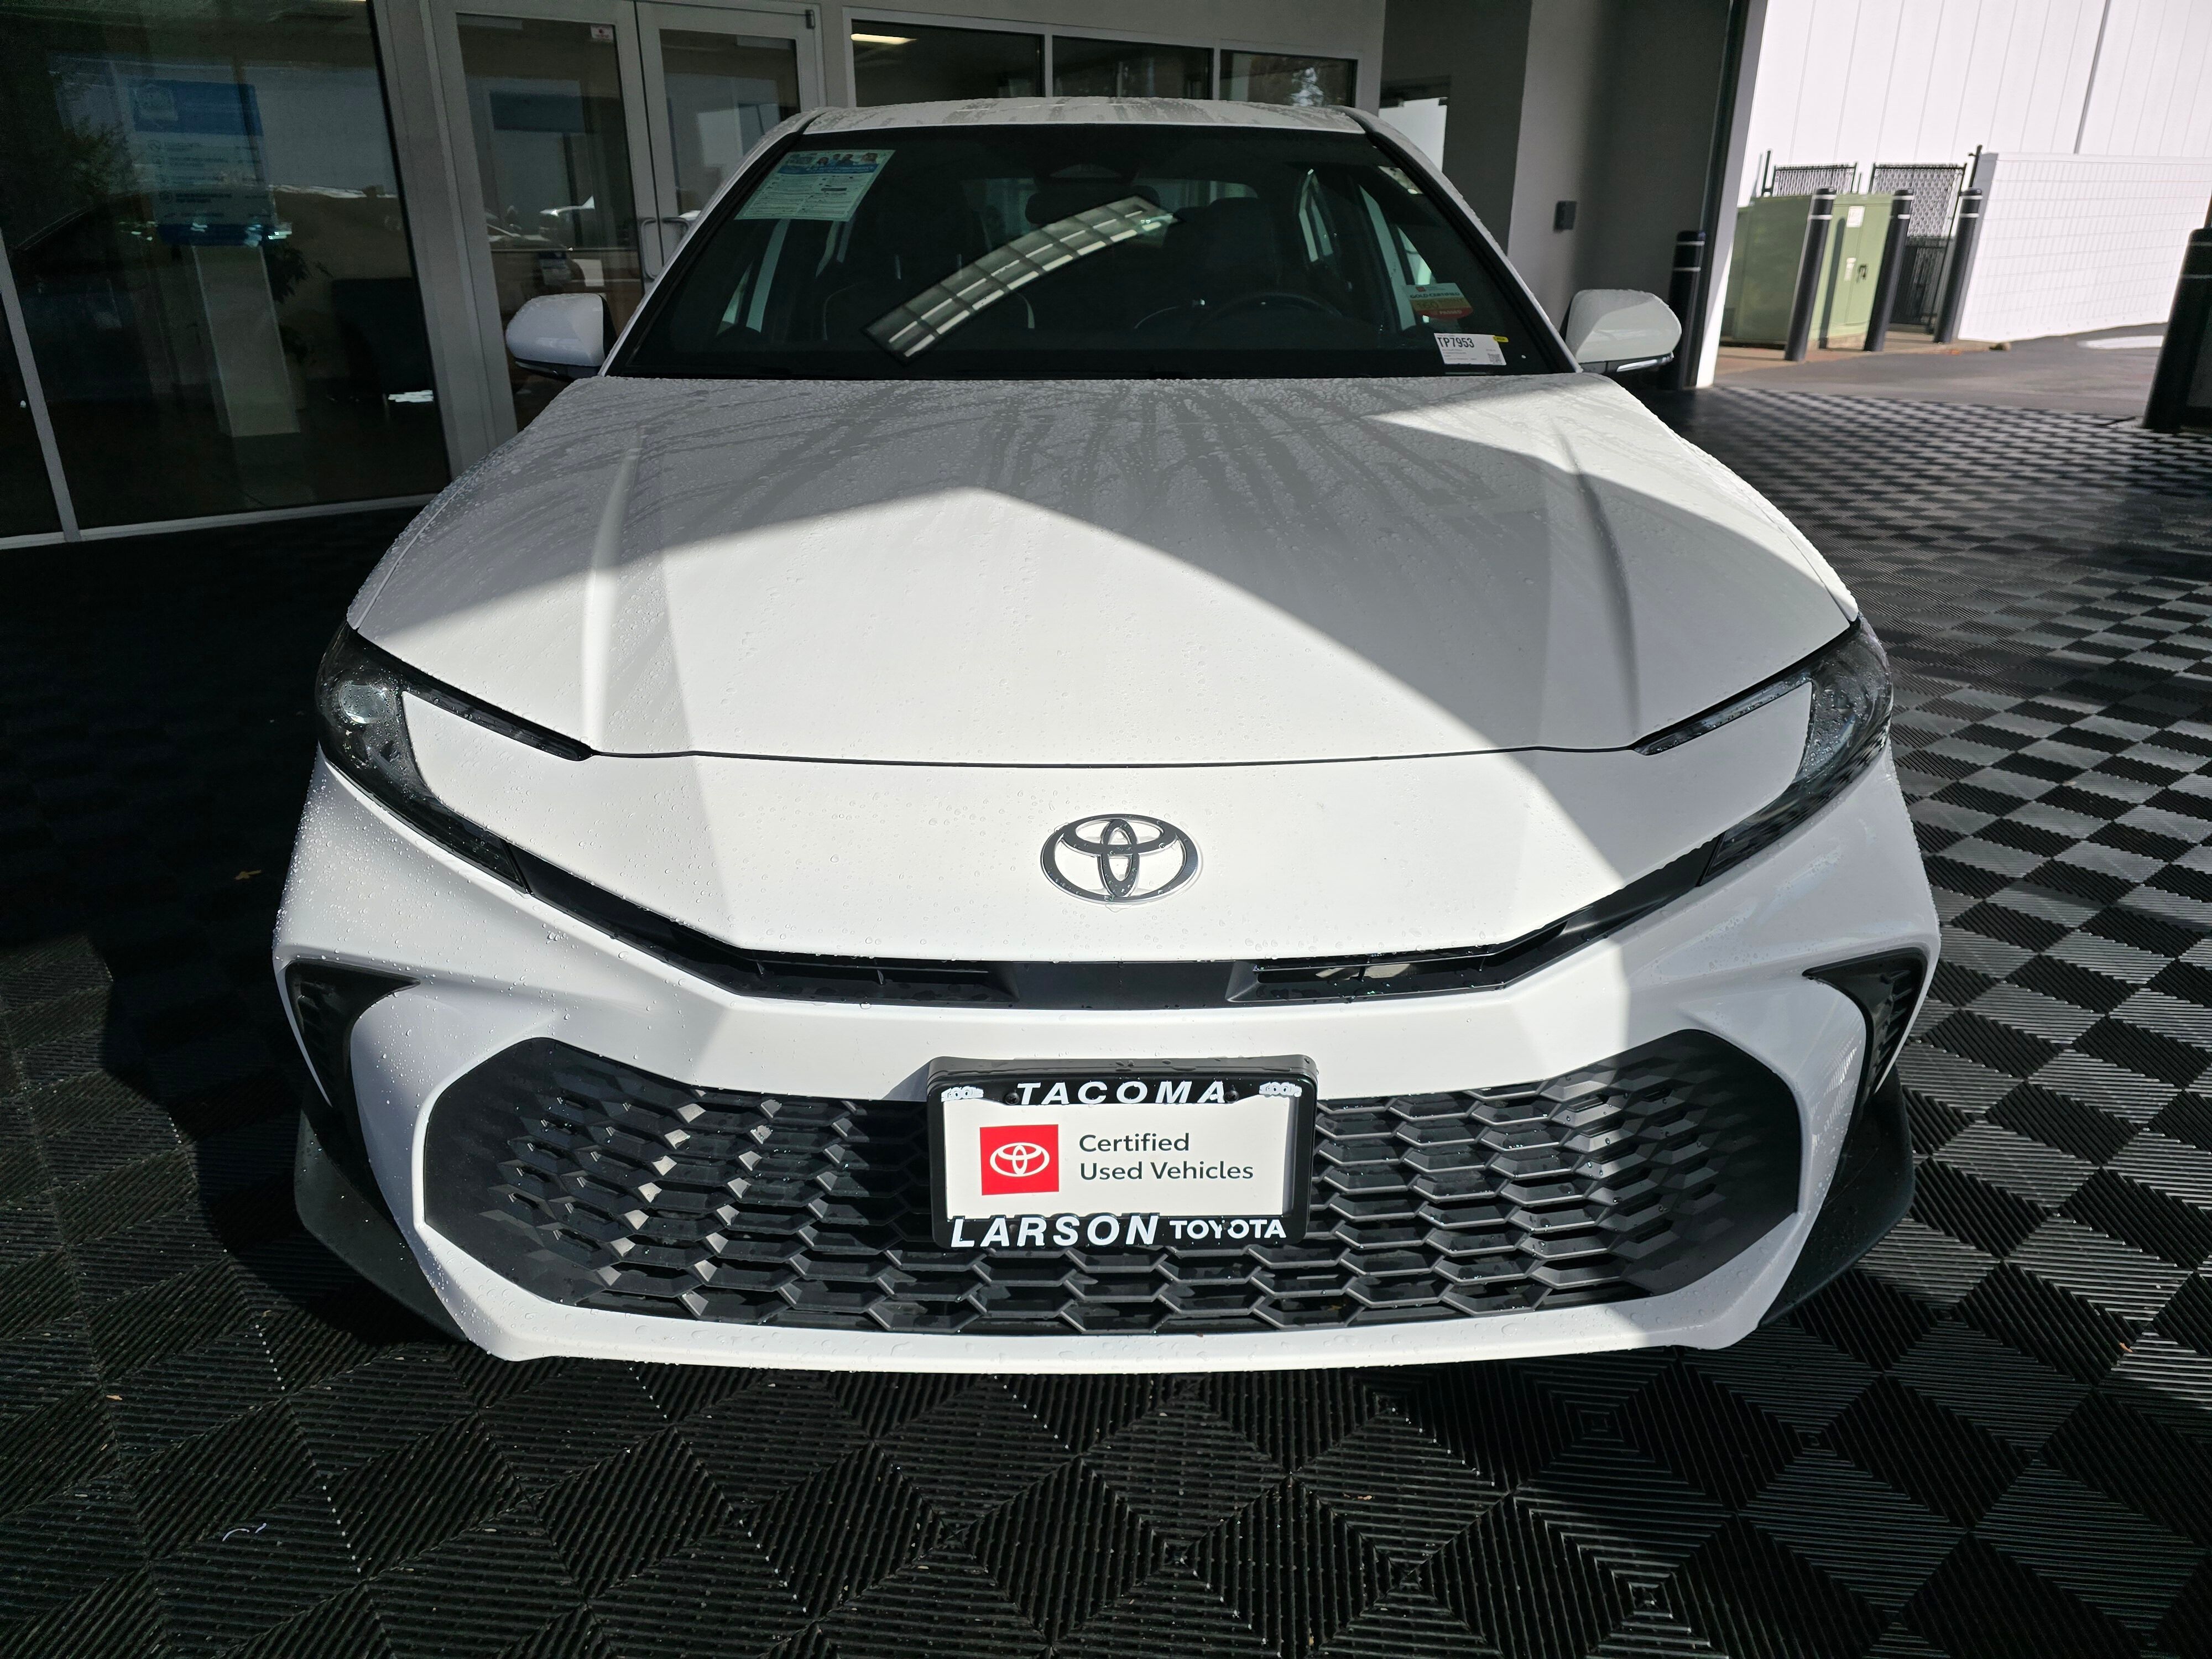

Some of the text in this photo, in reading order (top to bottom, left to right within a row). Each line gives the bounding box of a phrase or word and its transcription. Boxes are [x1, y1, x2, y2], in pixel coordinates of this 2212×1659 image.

[1437, 337, 1475, 348] TP7953
[1016, 1081, 1225, 1105] TACOMA
[1079, 1133, 1190, 1153] Certified
[1080, 1161, 1254, 1181] Used Vehicles
[951, 1213, 1286, 1248] LARSON TOYOTA
